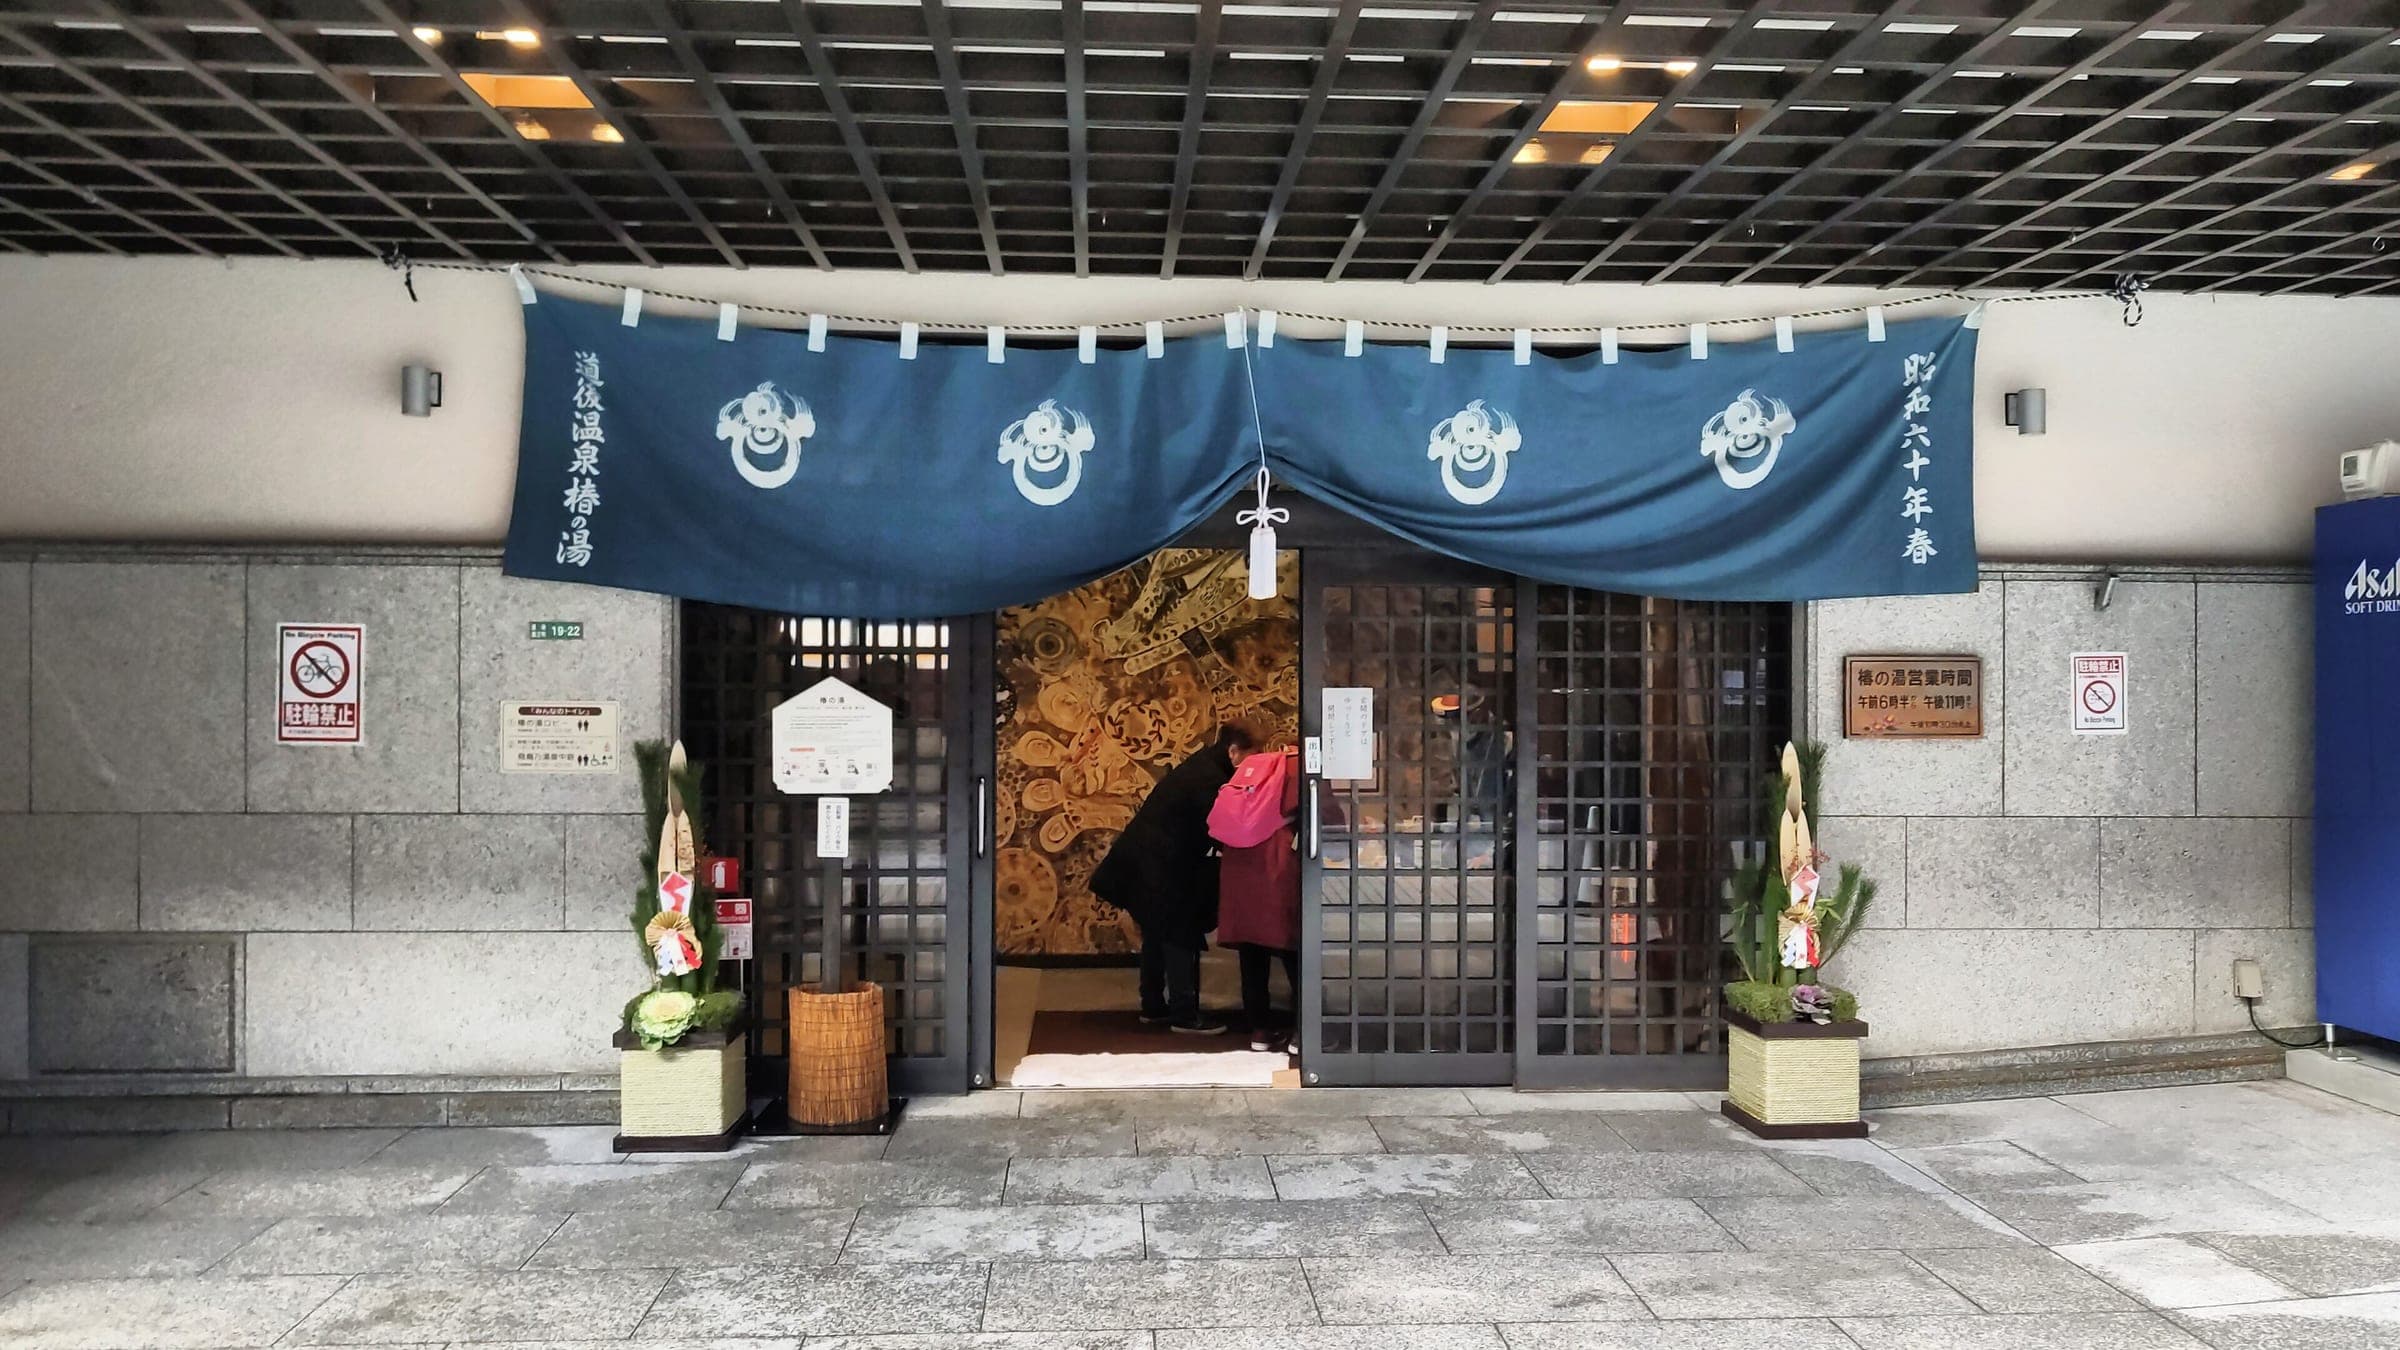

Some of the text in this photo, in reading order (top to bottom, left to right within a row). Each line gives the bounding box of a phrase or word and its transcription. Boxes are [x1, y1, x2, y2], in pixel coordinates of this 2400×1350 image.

[556, 351, 605, 567] 道後温泉椿の湯
[1900, 352, 1938, 564] 昭和六十年春
[2345, 601, 2374, 614] SOFT
[552, 626, 580, 636] 19-22
[2079, 659, 2119, 672] 駐輪禁止
[1858, 668, 1972, 686] 椿の湯営業時間
[285, 703, 354, 726] 駐輪禁止
